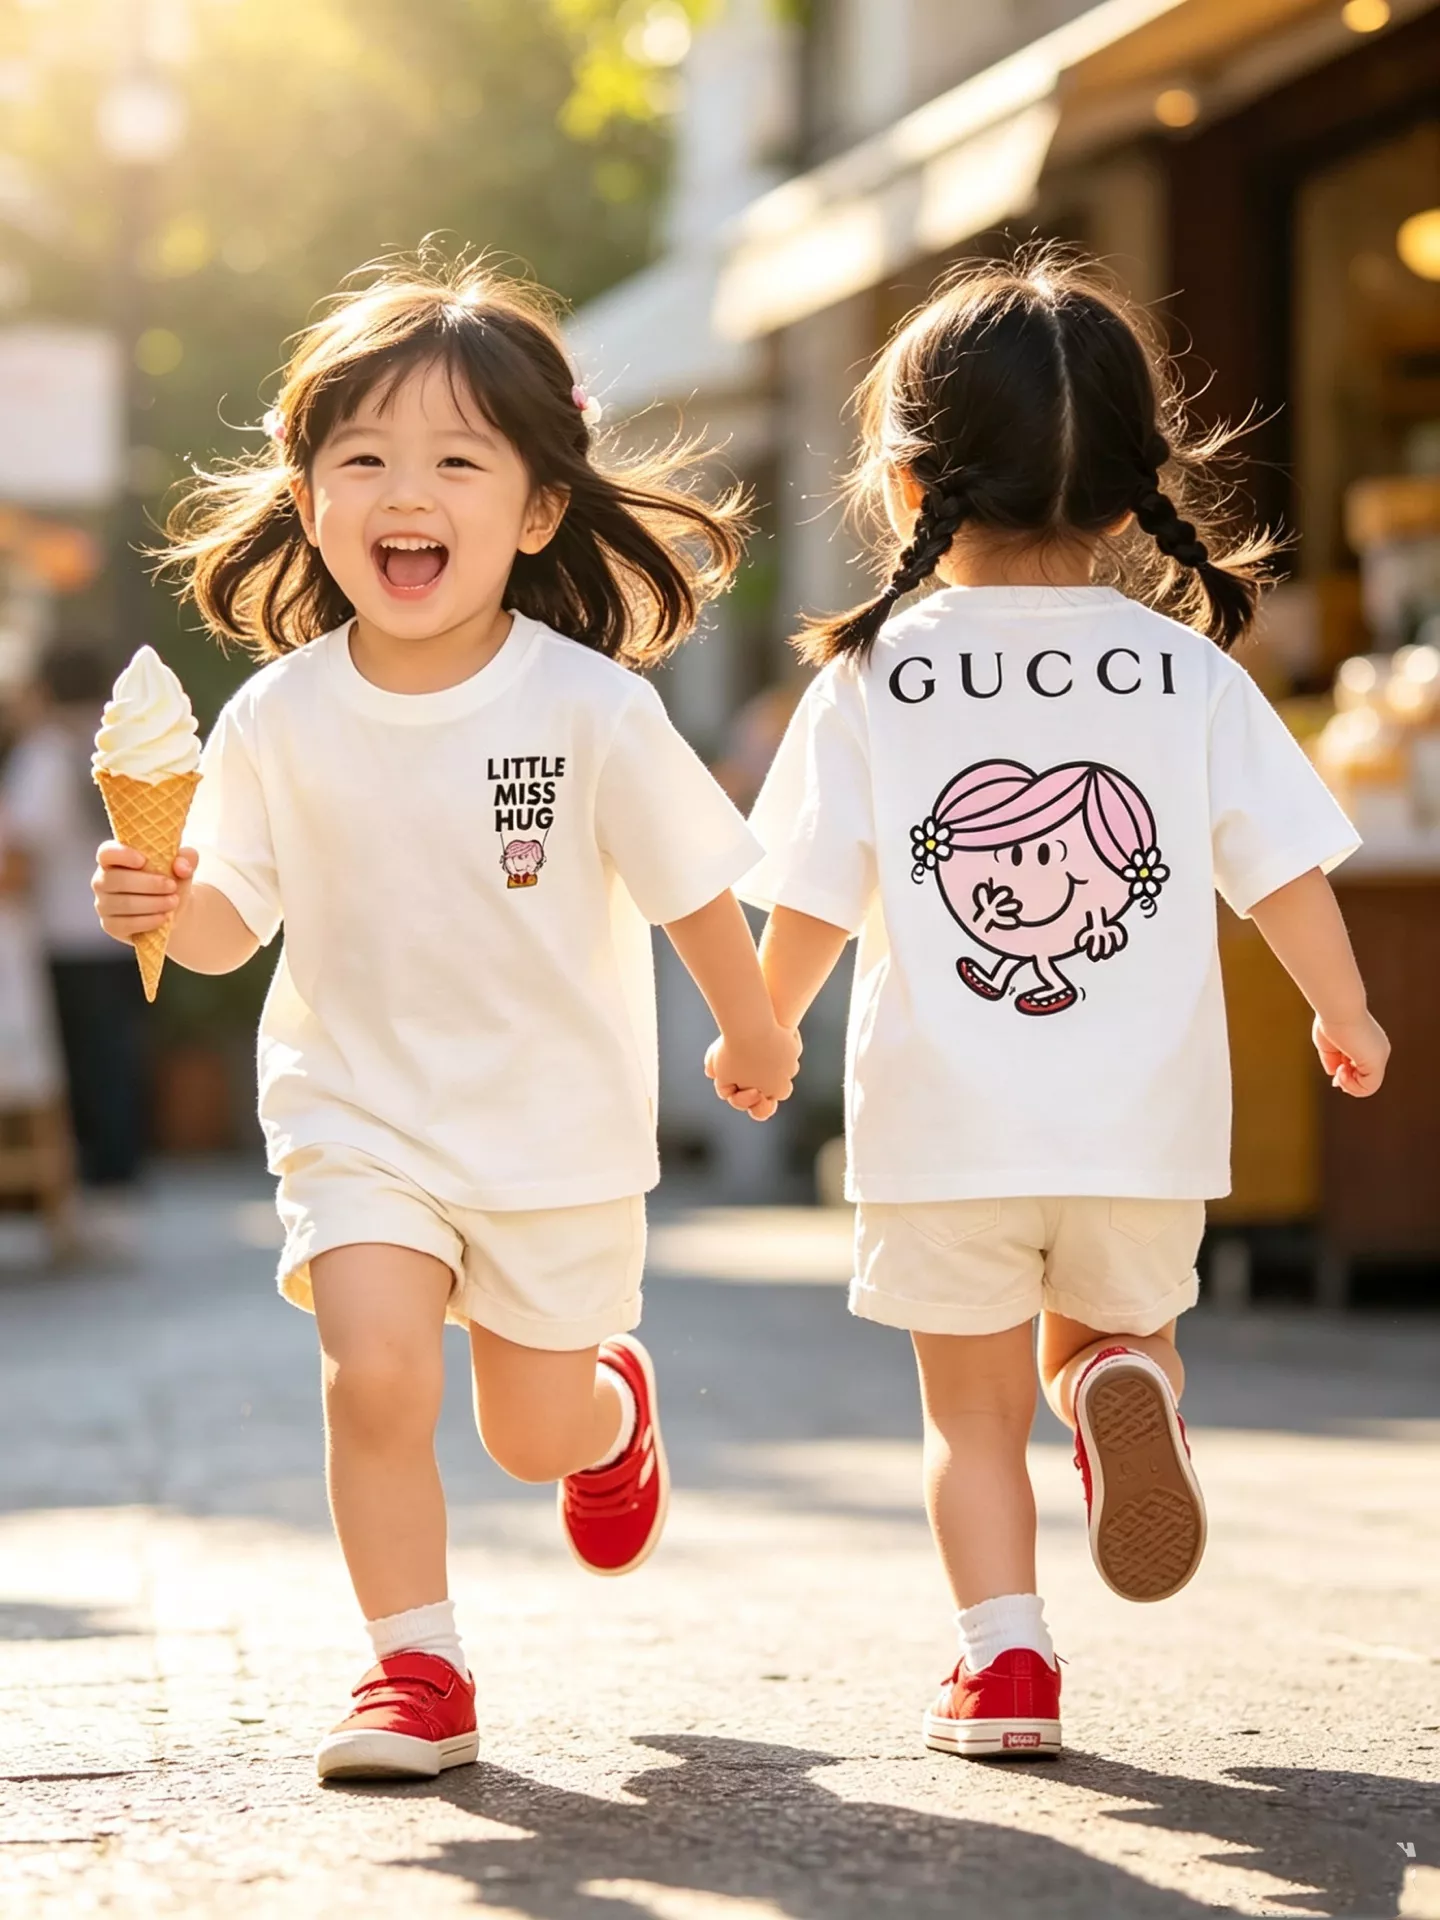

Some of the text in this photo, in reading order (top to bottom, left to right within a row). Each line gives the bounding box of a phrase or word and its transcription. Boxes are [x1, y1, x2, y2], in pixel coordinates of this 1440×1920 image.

[888, 648, 1176, 704] GUCCI
[487, 756, 566, 781] LITTLE
[493, 781, 556, 807] MISS
[495, 807, 554, 832] HUG
